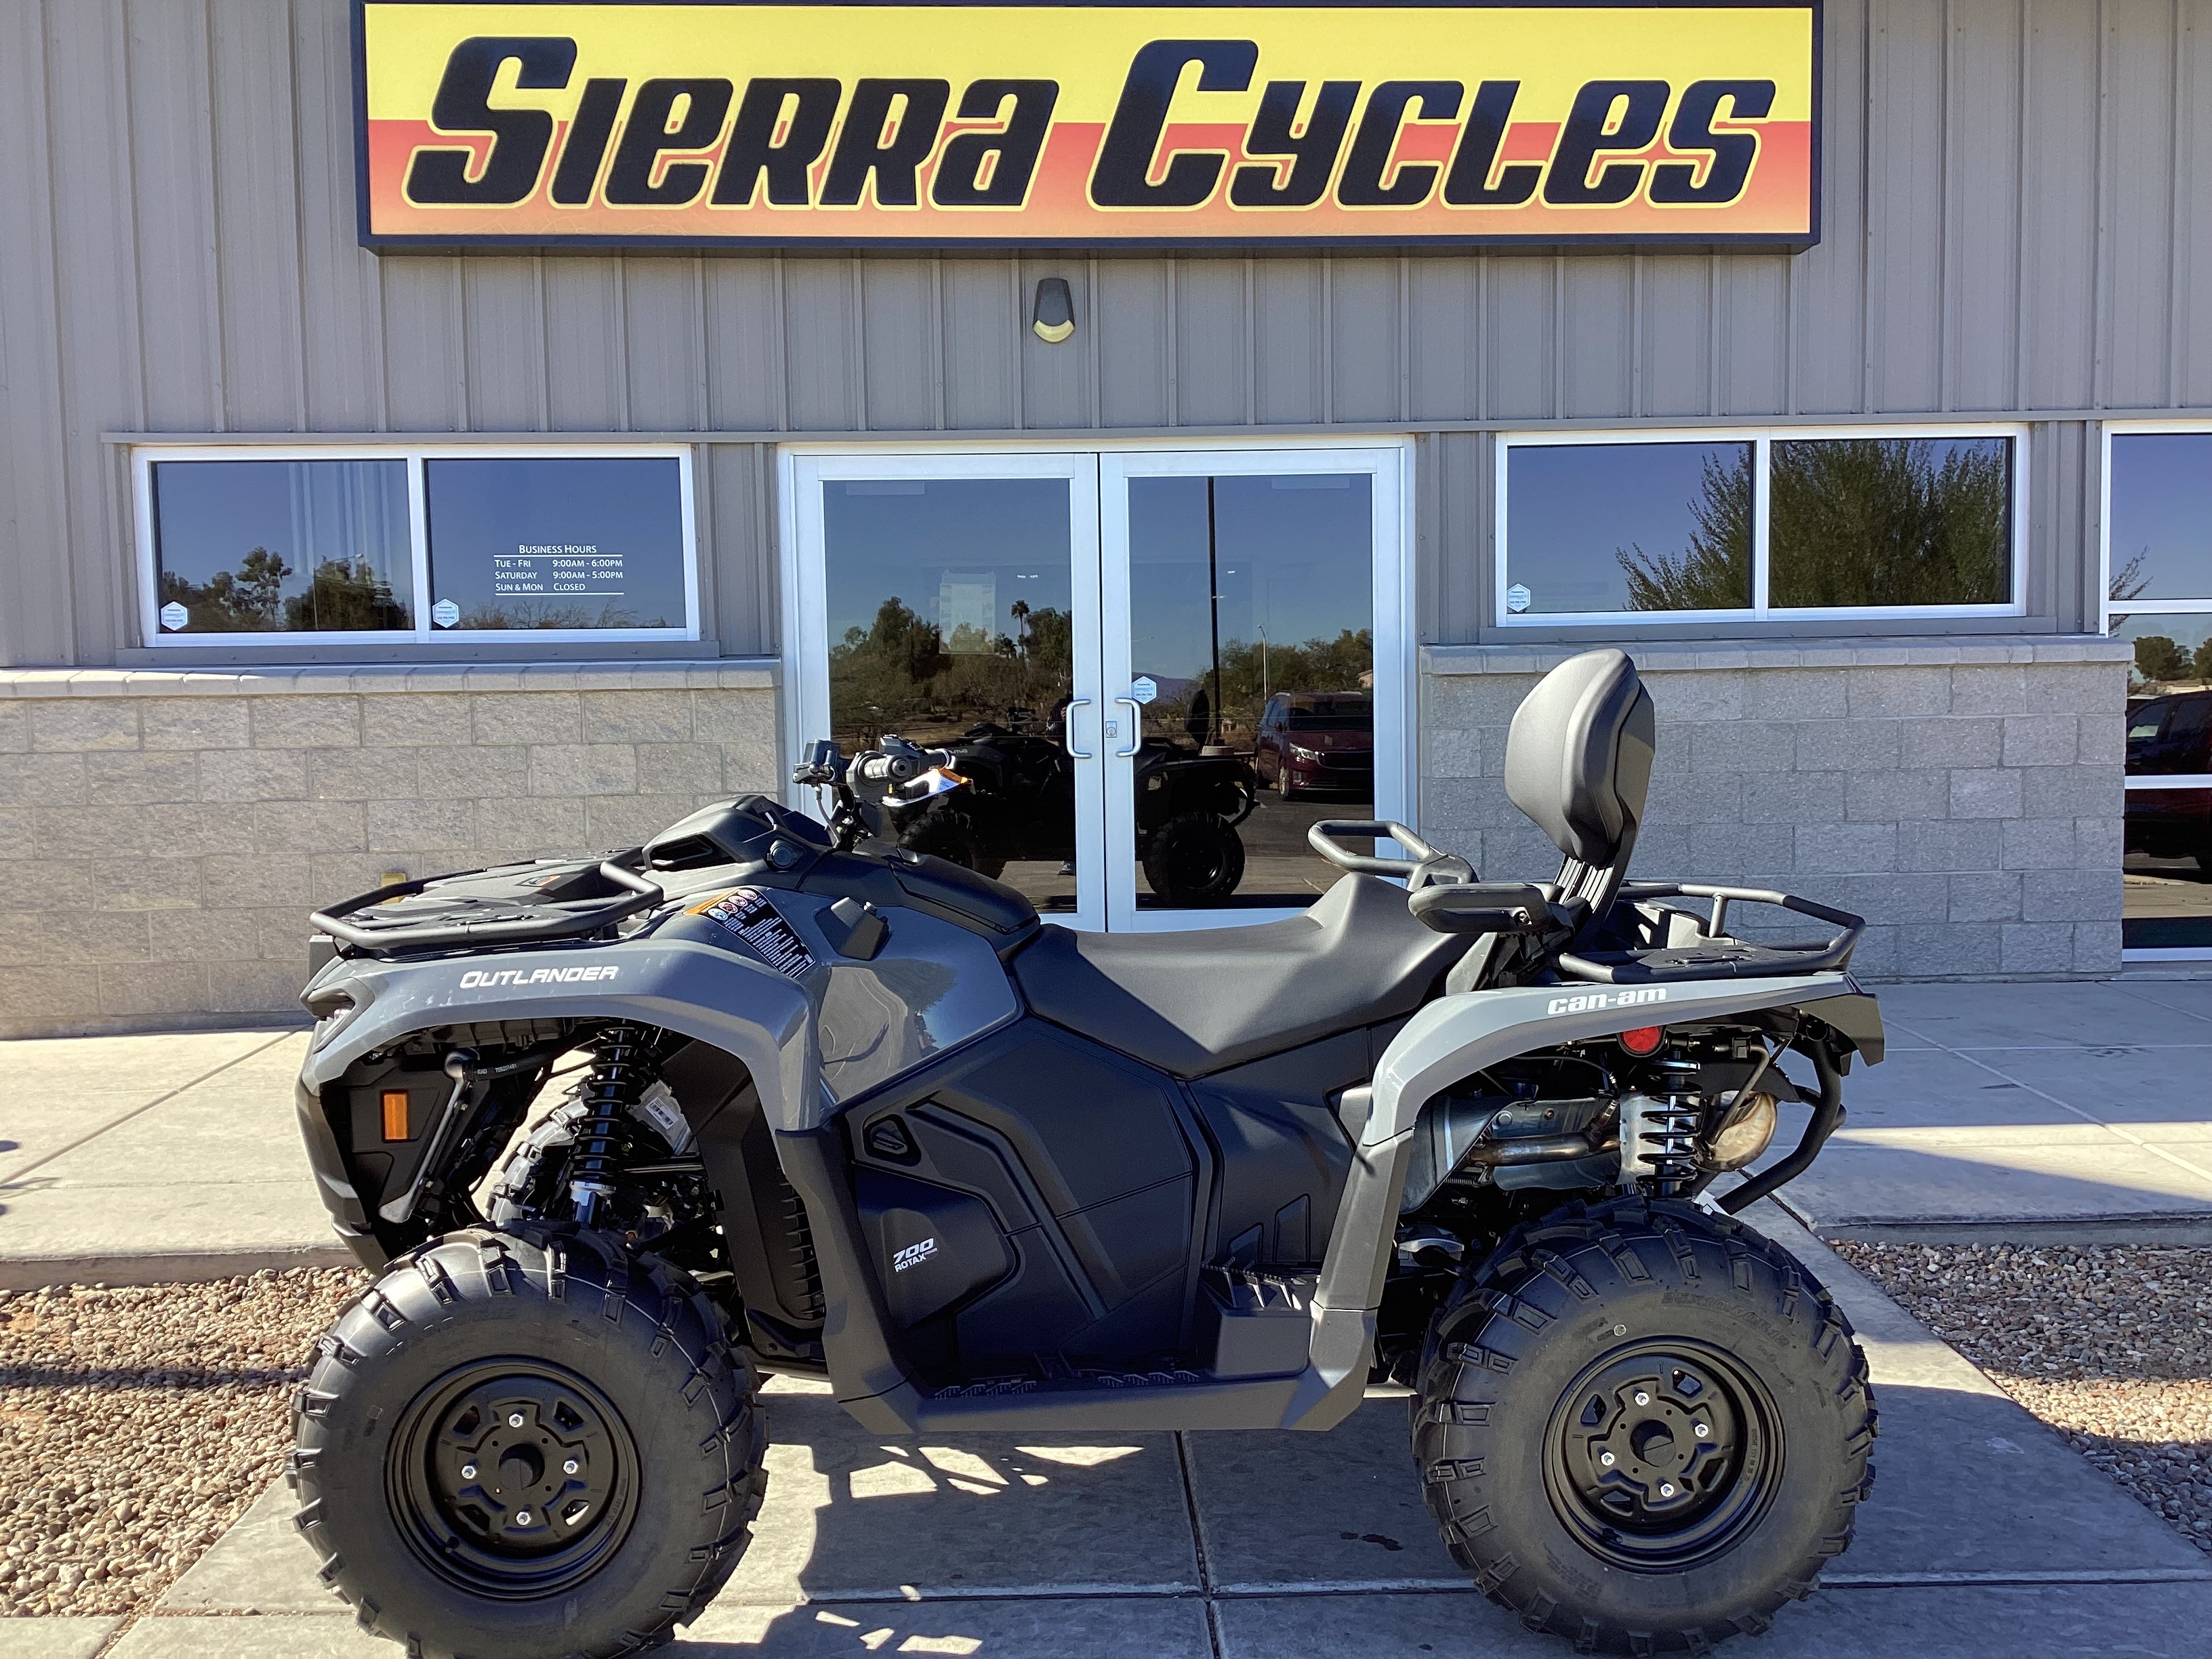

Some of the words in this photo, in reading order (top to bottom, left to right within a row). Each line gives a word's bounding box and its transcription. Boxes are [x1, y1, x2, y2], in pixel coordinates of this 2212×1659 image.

[552, 559, 585, 567] 9:00AM
[591, 559, 623, 567] 6:00PM
[495, 571, 537, 579] SATURDAY
[552, 571, 585, 579] 9:00AM
[592, 571, 623, 579] 5:00PM
[514, 583, 521, 591] &
[459, 966, 619, 989] OUTLANDER
[1547, 987, 1667, 1015] can-am
[893, 1237, 934, 1265] 700
[894, 1252, 927, 1273] ROTAX
